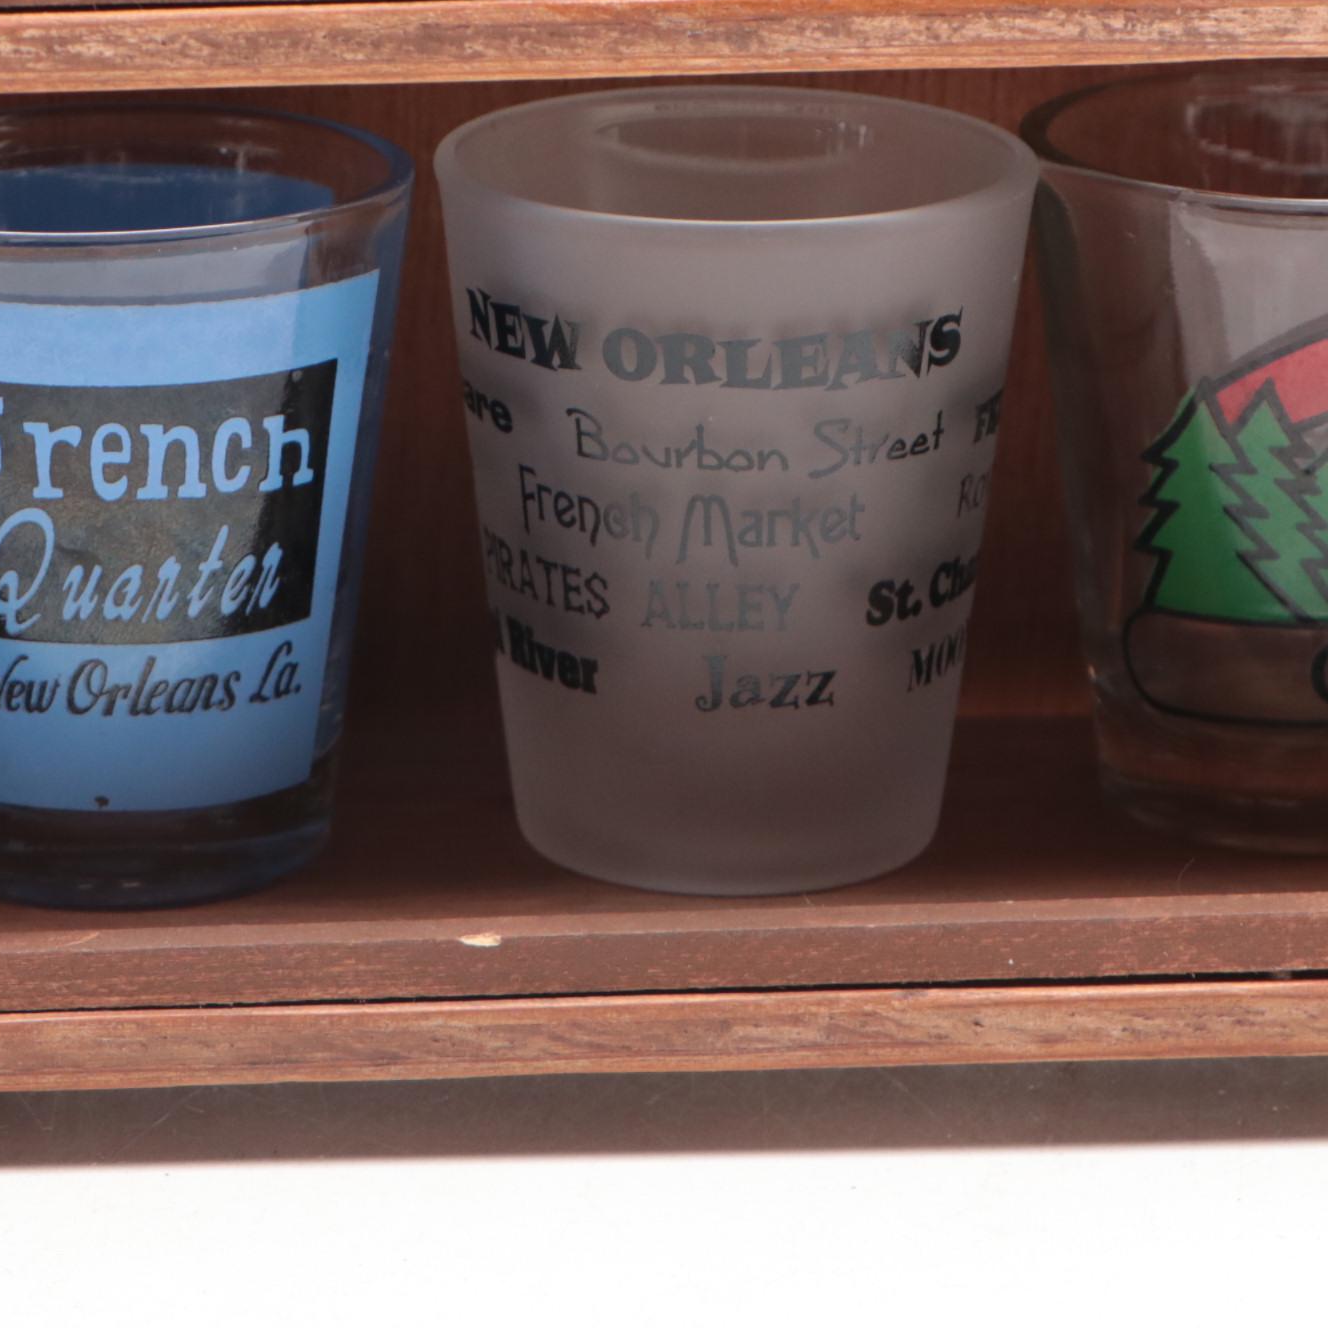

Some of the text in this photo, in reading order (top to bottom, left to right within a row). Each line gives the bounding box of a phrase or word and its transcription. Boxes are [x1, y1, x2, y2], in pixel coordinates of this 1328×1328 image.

[465, 287, 963, 392] NEW ORLEANS
[566, 407, 945, 479] Bourbon Street
[517, 464, 865, 567] French Market
[640, 577, 802, 633] ALLEY
[865, 577, 922, 627] St.
[67, 658, 240, 717] Orleans
[249, 643, 303, 704] La.
[506, 614, 600, 695] River
[694, 651, 838, 714] Jazz
